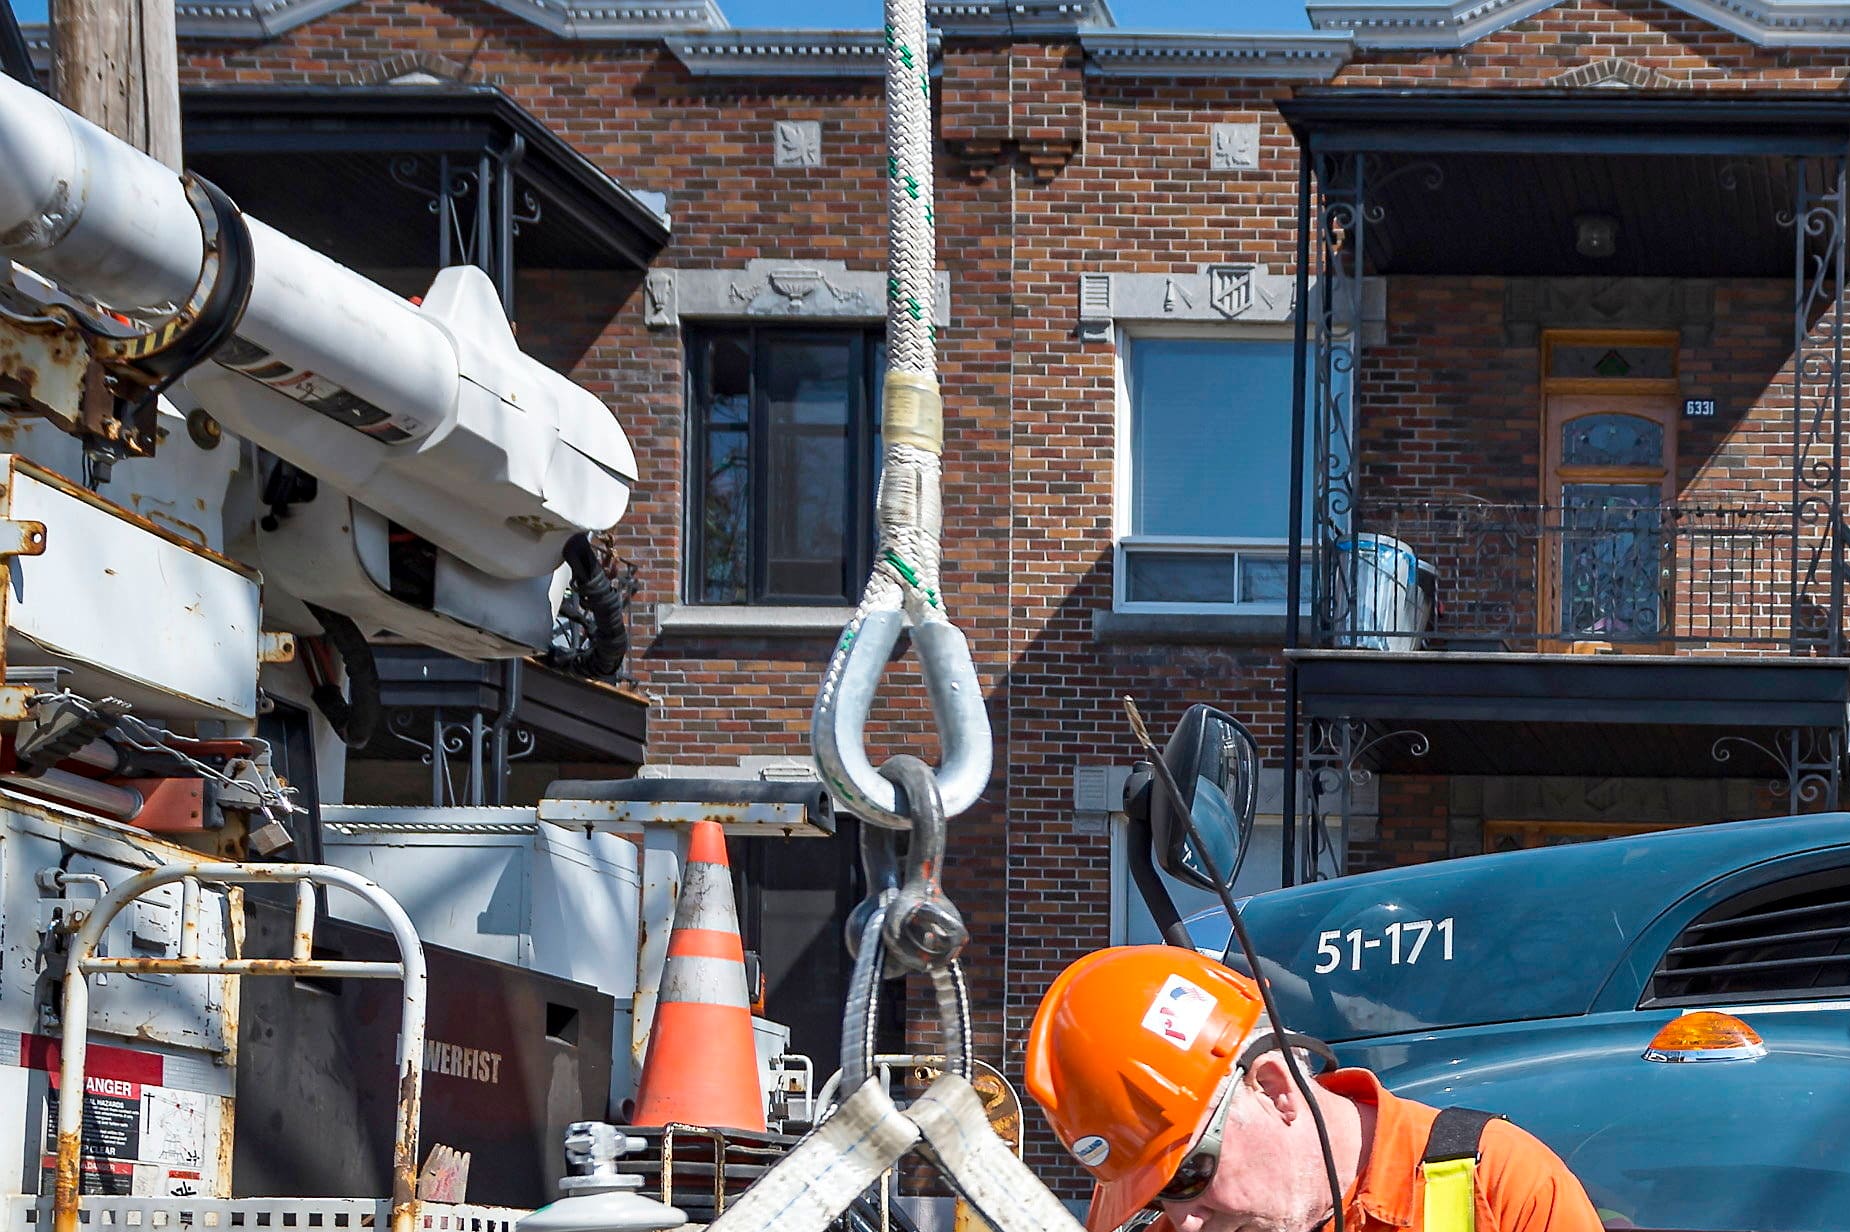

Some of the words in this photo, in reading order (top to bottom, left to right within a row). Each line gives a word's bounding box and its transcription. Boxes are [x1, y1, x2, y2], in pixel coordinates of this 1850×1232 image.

[1687, 400, 1714, 415] 6331
[1314, 917, 1454, 974] 51-171
[396, 1033, 502, 1084] WERFIST
[86, 1076, 132, 1097] ANGER
